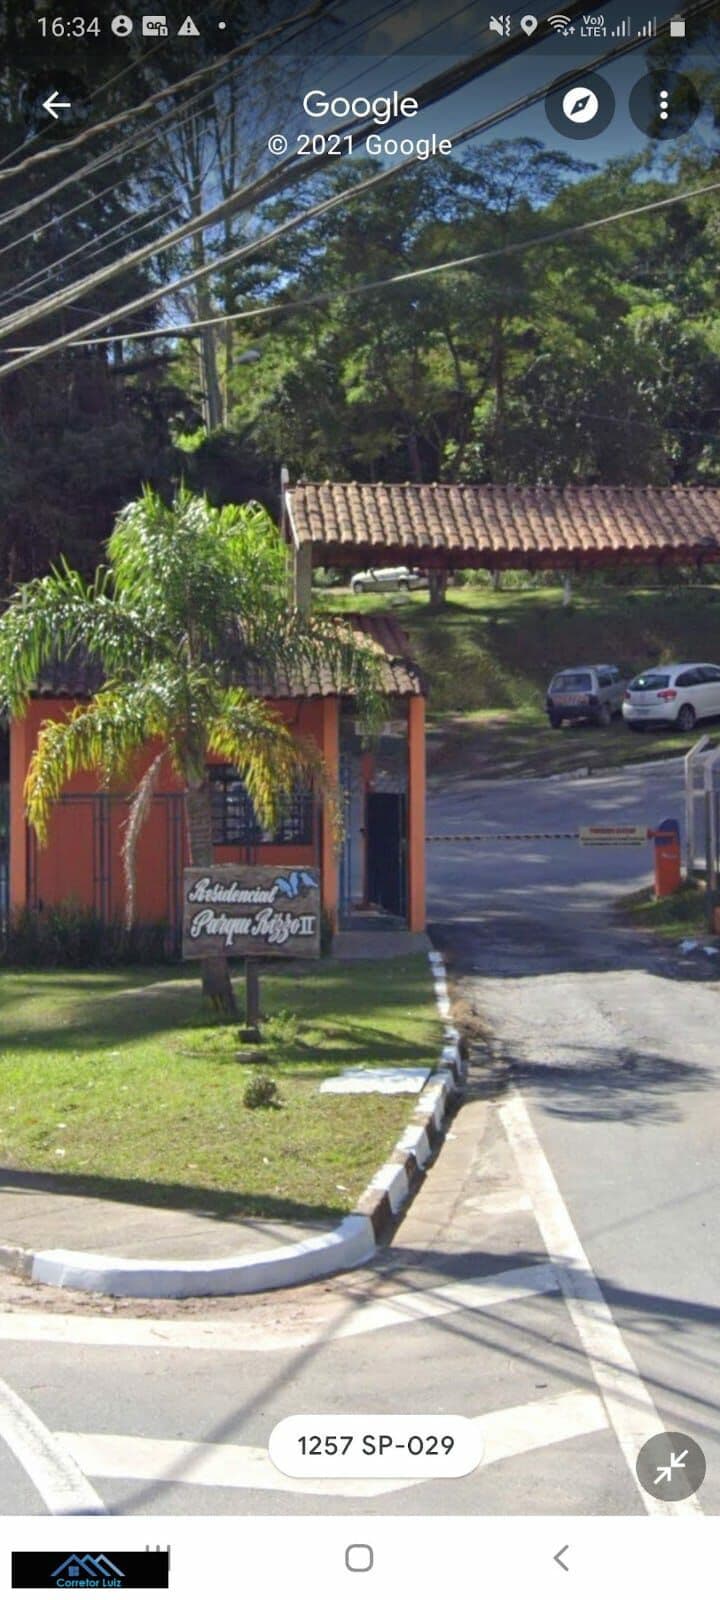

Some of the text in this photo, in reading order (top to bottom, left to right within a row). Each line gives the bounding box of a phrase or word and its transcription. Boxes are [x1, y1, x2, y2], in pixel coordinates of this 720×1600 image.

[188, 877, 279, 903] Residencial
[250, 907, 300, 944] Rizzo
[298, 915, 317, 935] II
